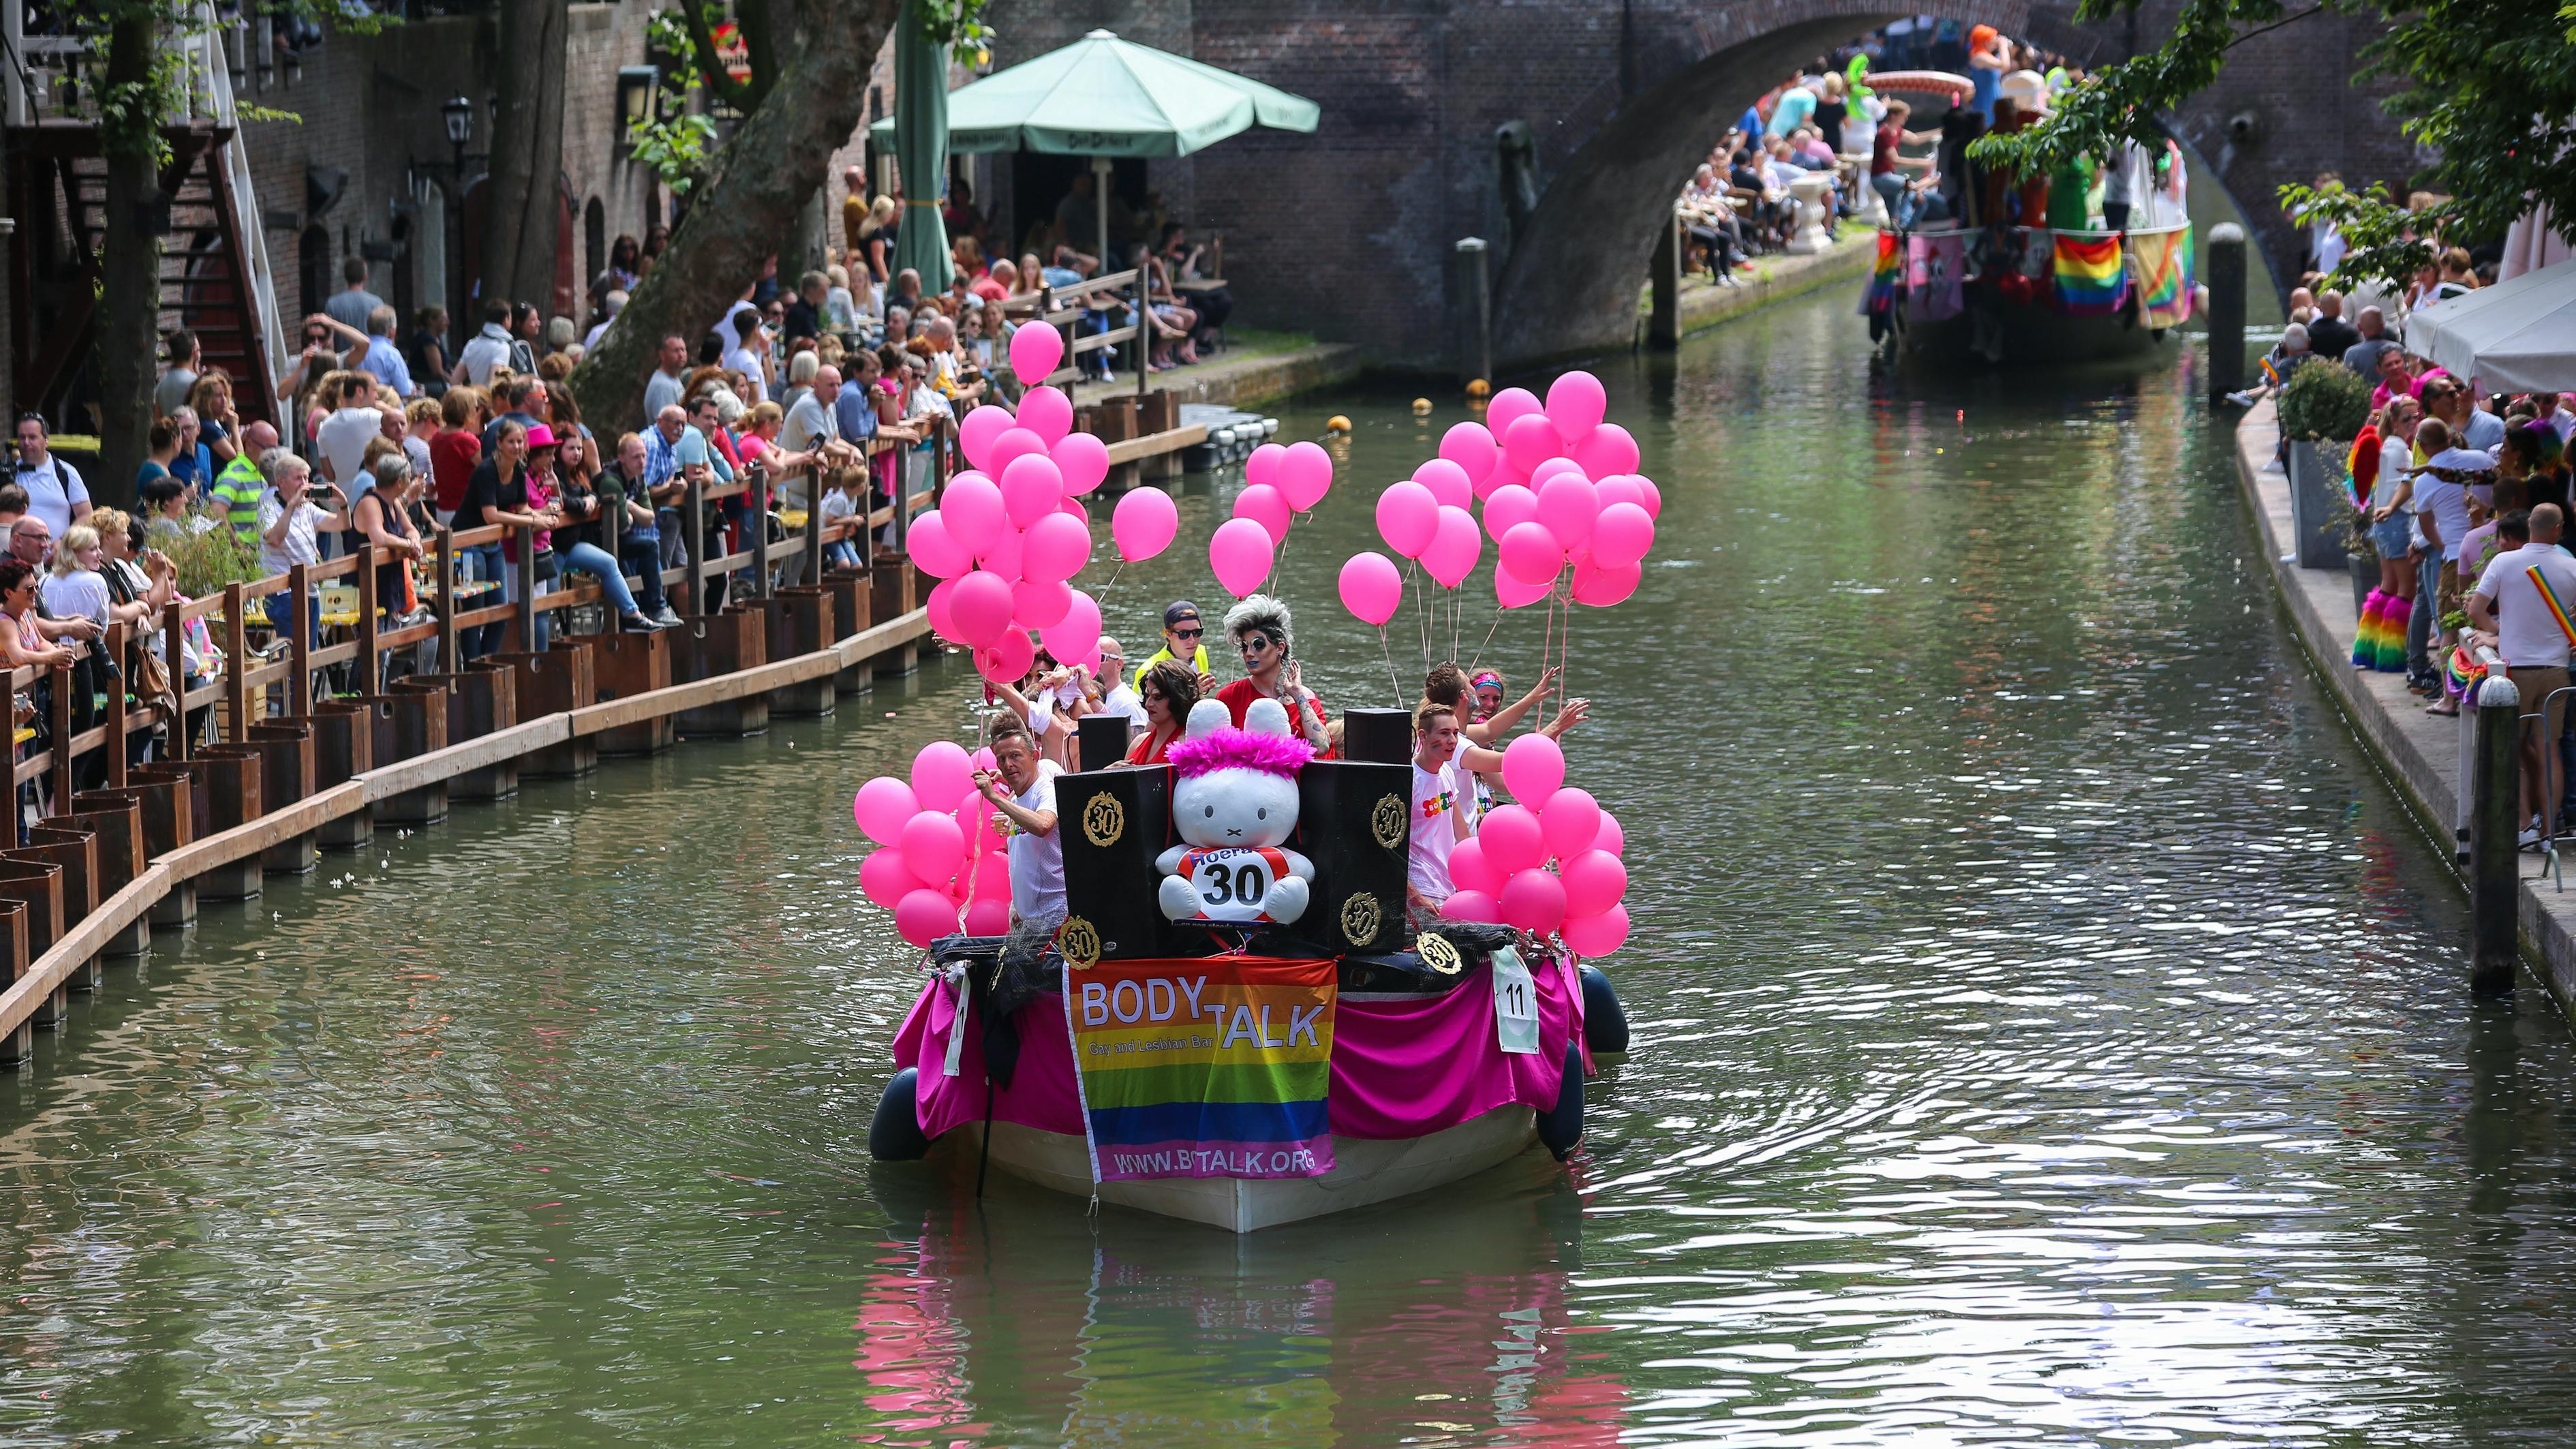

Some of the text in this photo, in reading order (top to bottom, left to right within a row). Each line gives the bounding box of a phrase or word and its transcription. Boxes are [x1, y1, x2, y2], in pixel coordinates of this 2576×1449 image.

[1090, 806, 1116, 836] 30
[1378, 808, 1400, 837] 30
[1203, 864, 1264, 906] 30
[1347, 902, 1373, 934] 30
[1067, 931, 1093, 958] 30
[1424, 939, 1454, 966] 30
[1082, 975, 1325, 1049] BODY TALK
[1505, 983, 1525, 1016] 11
[1088, 1035, 1213, 1058] Gay and Lesbian Bar
